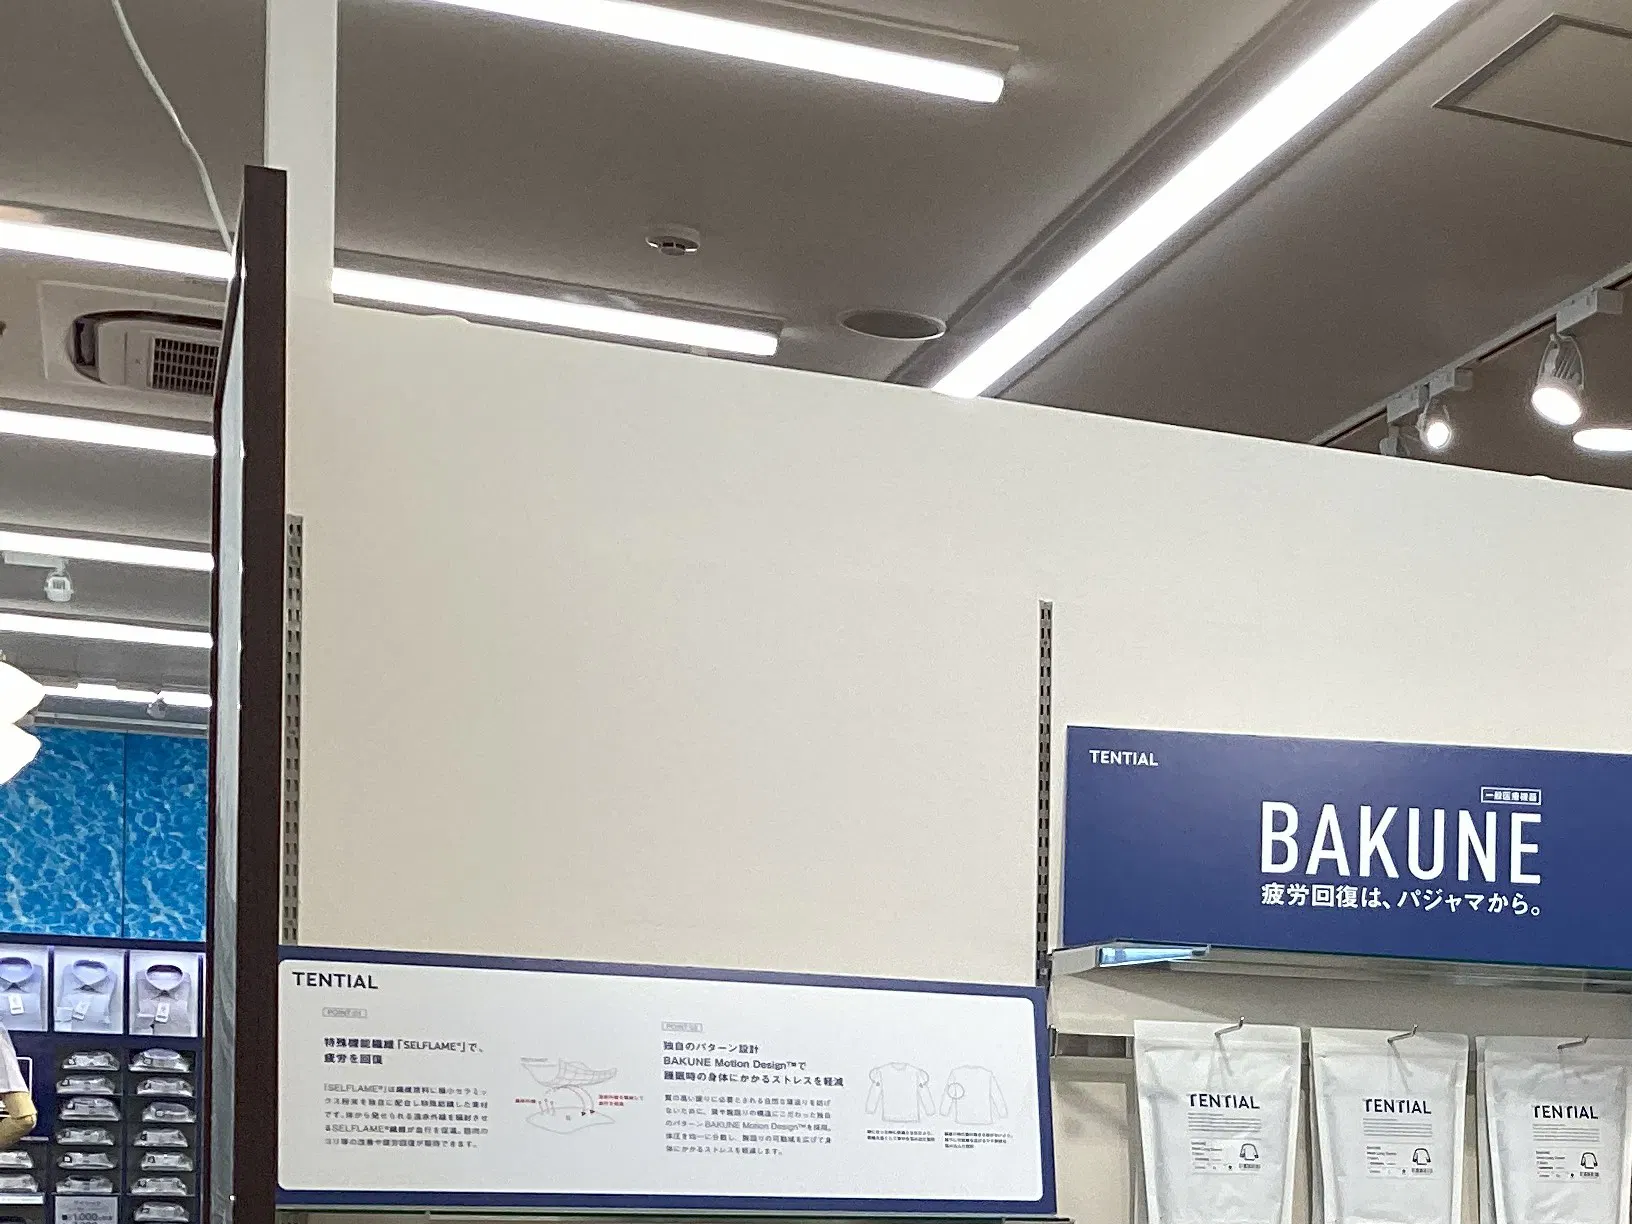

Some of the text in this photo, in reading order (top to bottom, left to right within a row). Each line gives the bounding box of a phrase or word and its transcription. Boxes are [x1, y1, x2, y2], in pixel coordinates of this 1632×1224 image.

[1089, 749, 1159, 767] TENTIAL
[1260, 800, 1542, 885] BAKUNE
[1261, 881, 1541, 917] 疲労回復は、パジャマから。
[292, 971, 379, 990] TENTIAL
[663, 1056, 711, 1067] BAKUNE
[715, 1058, 750, 1069] Motion
[1188, 1093, 1260, 1109] TENTIAL
[1364, 1098, 1432, 1115] TENTIAL
[1532, 1105, 1599, 1120] TENTIAL
